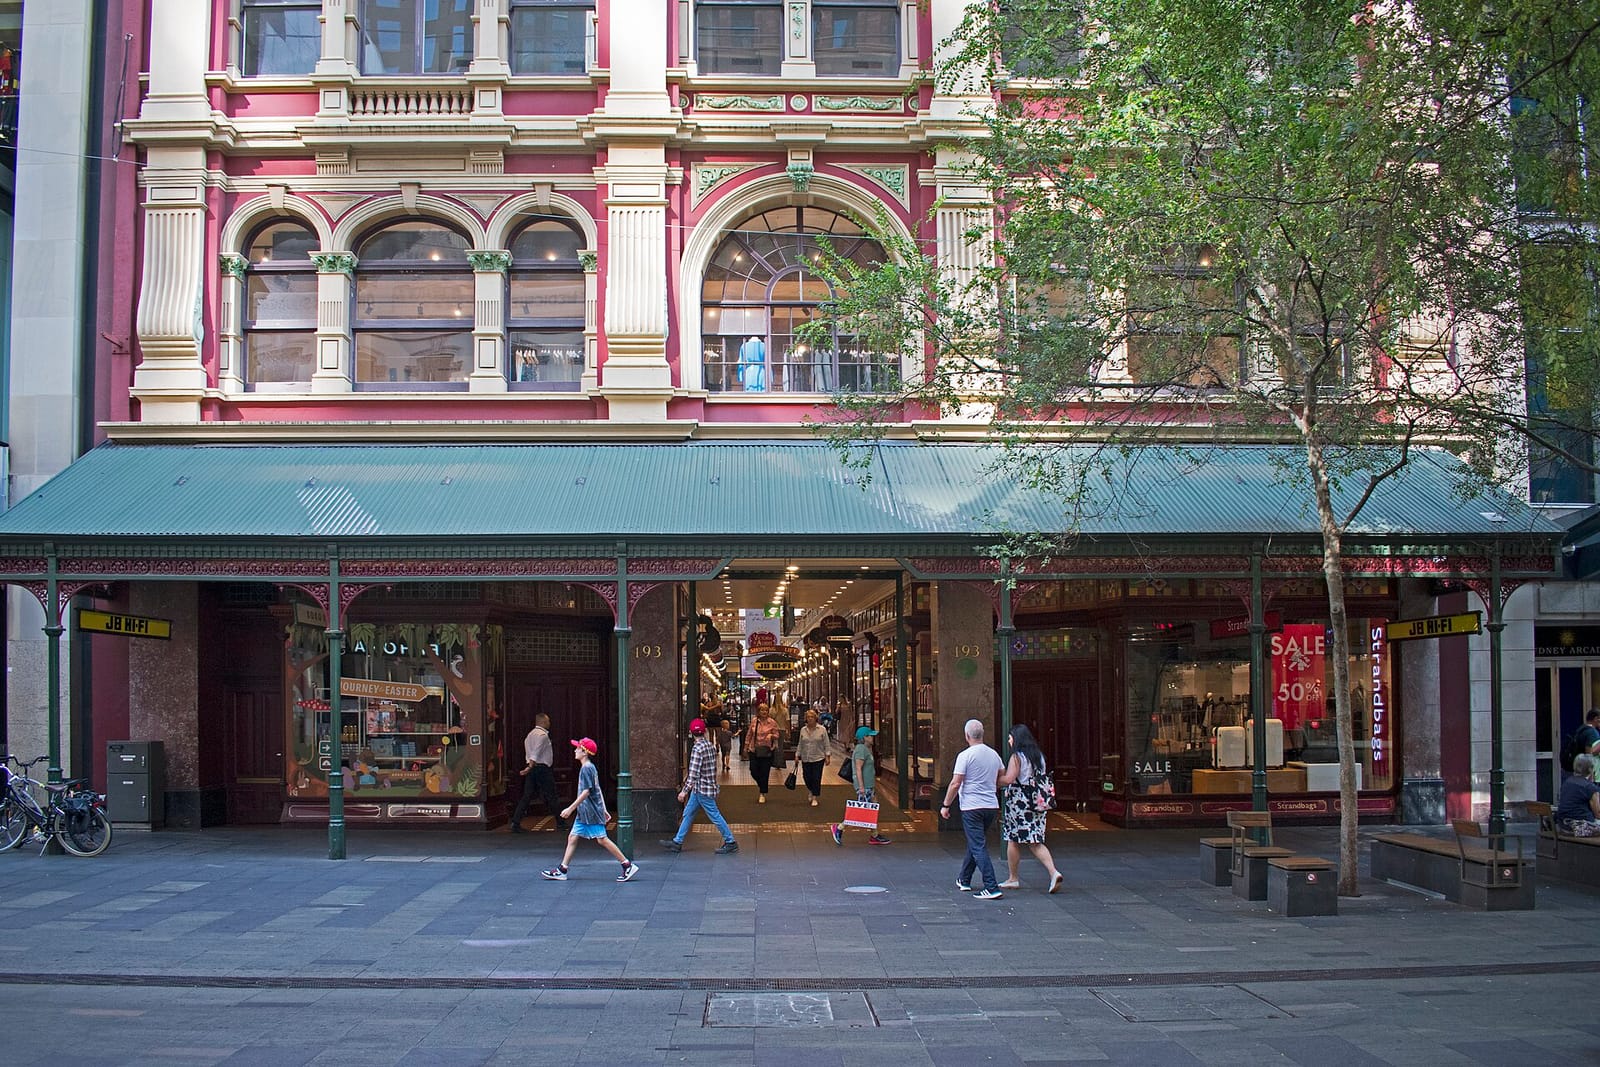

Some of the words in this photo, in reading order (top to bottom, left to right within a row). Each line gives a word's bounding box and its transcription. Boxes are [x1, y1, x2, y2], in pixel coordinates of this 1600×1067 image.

[105, 615, 122, 630] JB
[1227, 616, 1250, 632] Strand
[1408, 622, 1424, 635] JB
[635, 645, 661, 658] 193
[749, 646, 776, 654] SHOPPING
[955, 645, 980, 658] 193
[1271, 636, 1325, 656] SALE
[1537, 646, 1565, 655] DNEY
[385, 685, 417, 697] EASTER
[1371, 627, 1384, 761] Strandbags
[1134, 761, 1171, 773] SALE
[848, 801, 878, 809] MYER
[1276, 802, 1317, 811] Strandbags
